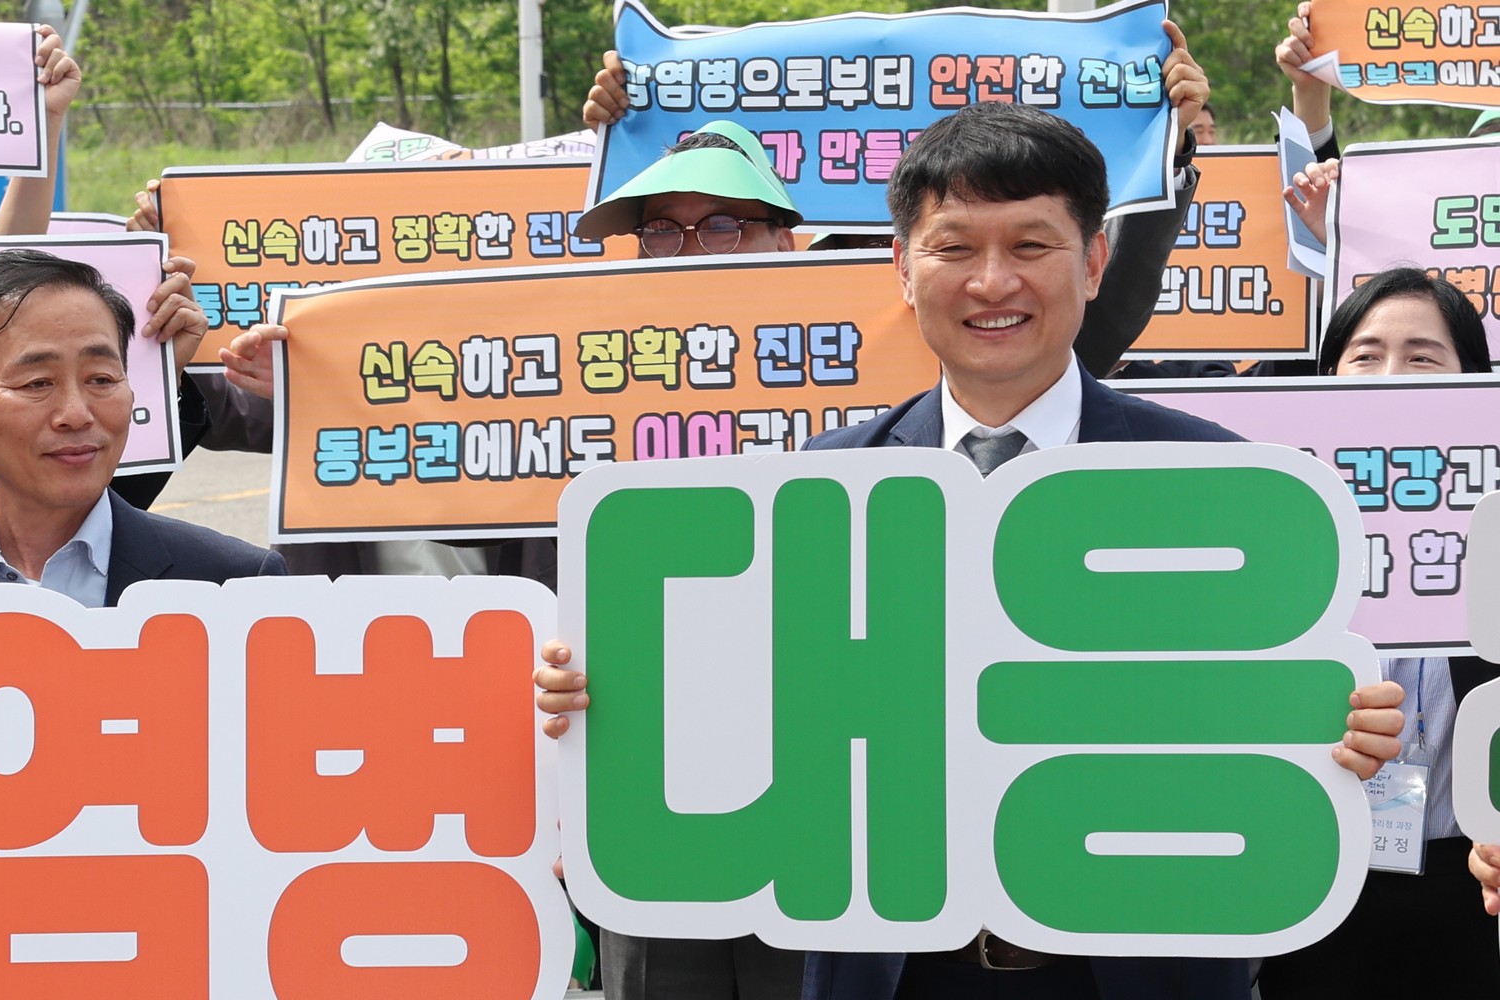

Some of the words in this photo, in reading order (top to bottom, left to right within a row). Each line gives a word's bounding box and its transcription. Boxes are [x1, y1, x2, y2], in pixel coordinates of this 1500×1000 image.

[621, 54, 913, 112] 감염병으로부터
[928, 53, 1066, 108] 안전한
[1077, 53, 1163, 109] 전남
[819, 129, 919, 185] 만들
[222, 216, 380, 266] 신속하고
[392, 211, 515, 263] 정확한
[360, 332, 561, 405] 신속하고
[579, 322, 739, 394] 정확한
[755, 321, 863, 388] 진단
[315, 415, 616, 486] 동부권에서도
[1409, 529, 1467, 596] 함
[586, 466, 1357, 936] 대응
